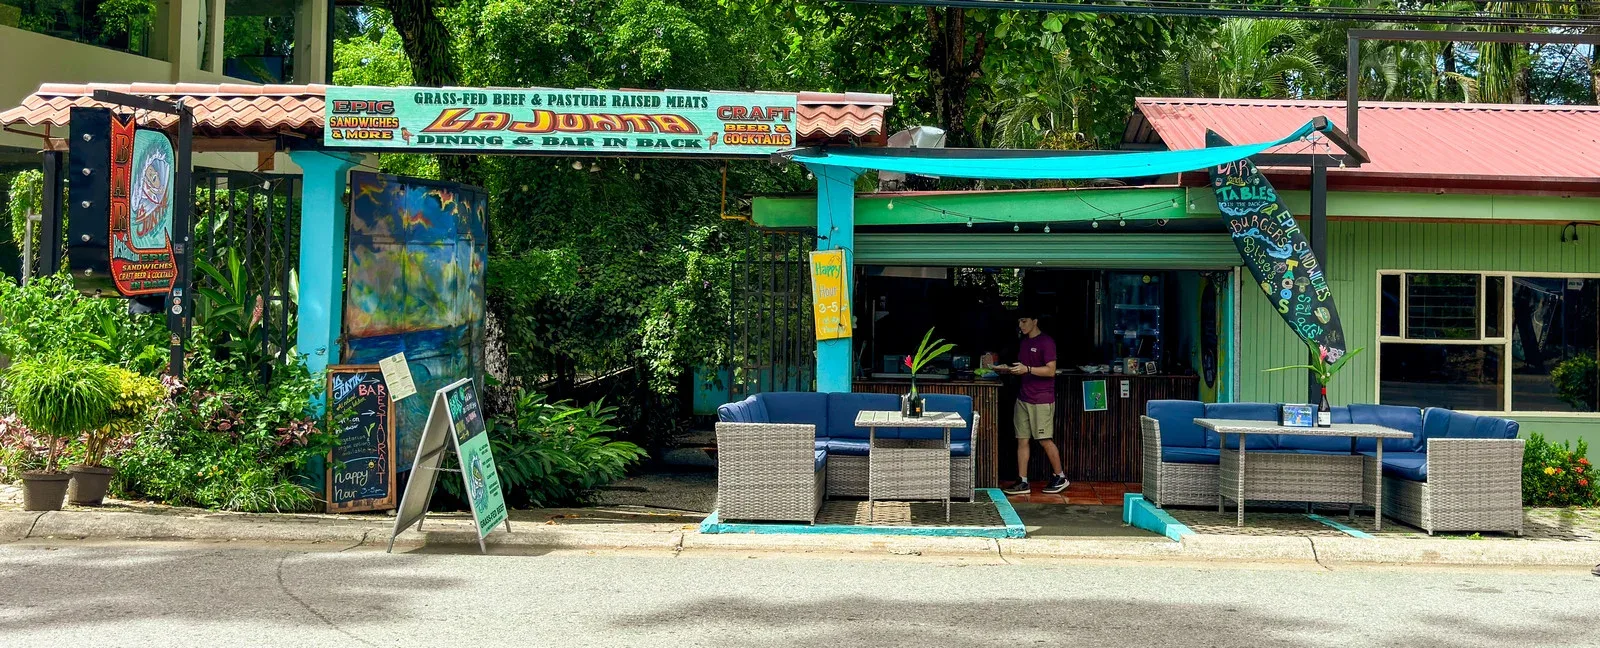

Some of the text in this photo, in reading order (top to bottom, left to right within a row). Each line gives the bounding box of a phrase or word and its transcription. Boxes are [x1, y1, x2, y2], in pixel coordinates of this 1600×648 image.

[332, 100, 394, 114] EPIC
[414, 92, 708, 108] GRASS-FED BEEF & PASTURE RAISED MEATS
[420, 108, 702, 134] LA JUNTA
[717, 106, 794, 121] CRAFT
[330, 116, 398, 128] SANDWICHES
[724, 124, 789, 133] BEER &
[332, 130, 393, 140] & MORE
[416, 135, 702, 148] DINING & BAR IN BACK
[724, 133, 792, 146] COCKTAILS
[113, 134, 130, 230] BAR
[1216, 186, 1277, 202] TABLES
[1230, 216, 1288, 248] BURGERS
[1276, 210, 1330, 302] EPIC SANDWICHES
[815, 262, 840, 278] Happy
[1278, 259, 1298, 314] TACOS
[358, 384, 386, 396] BAR
